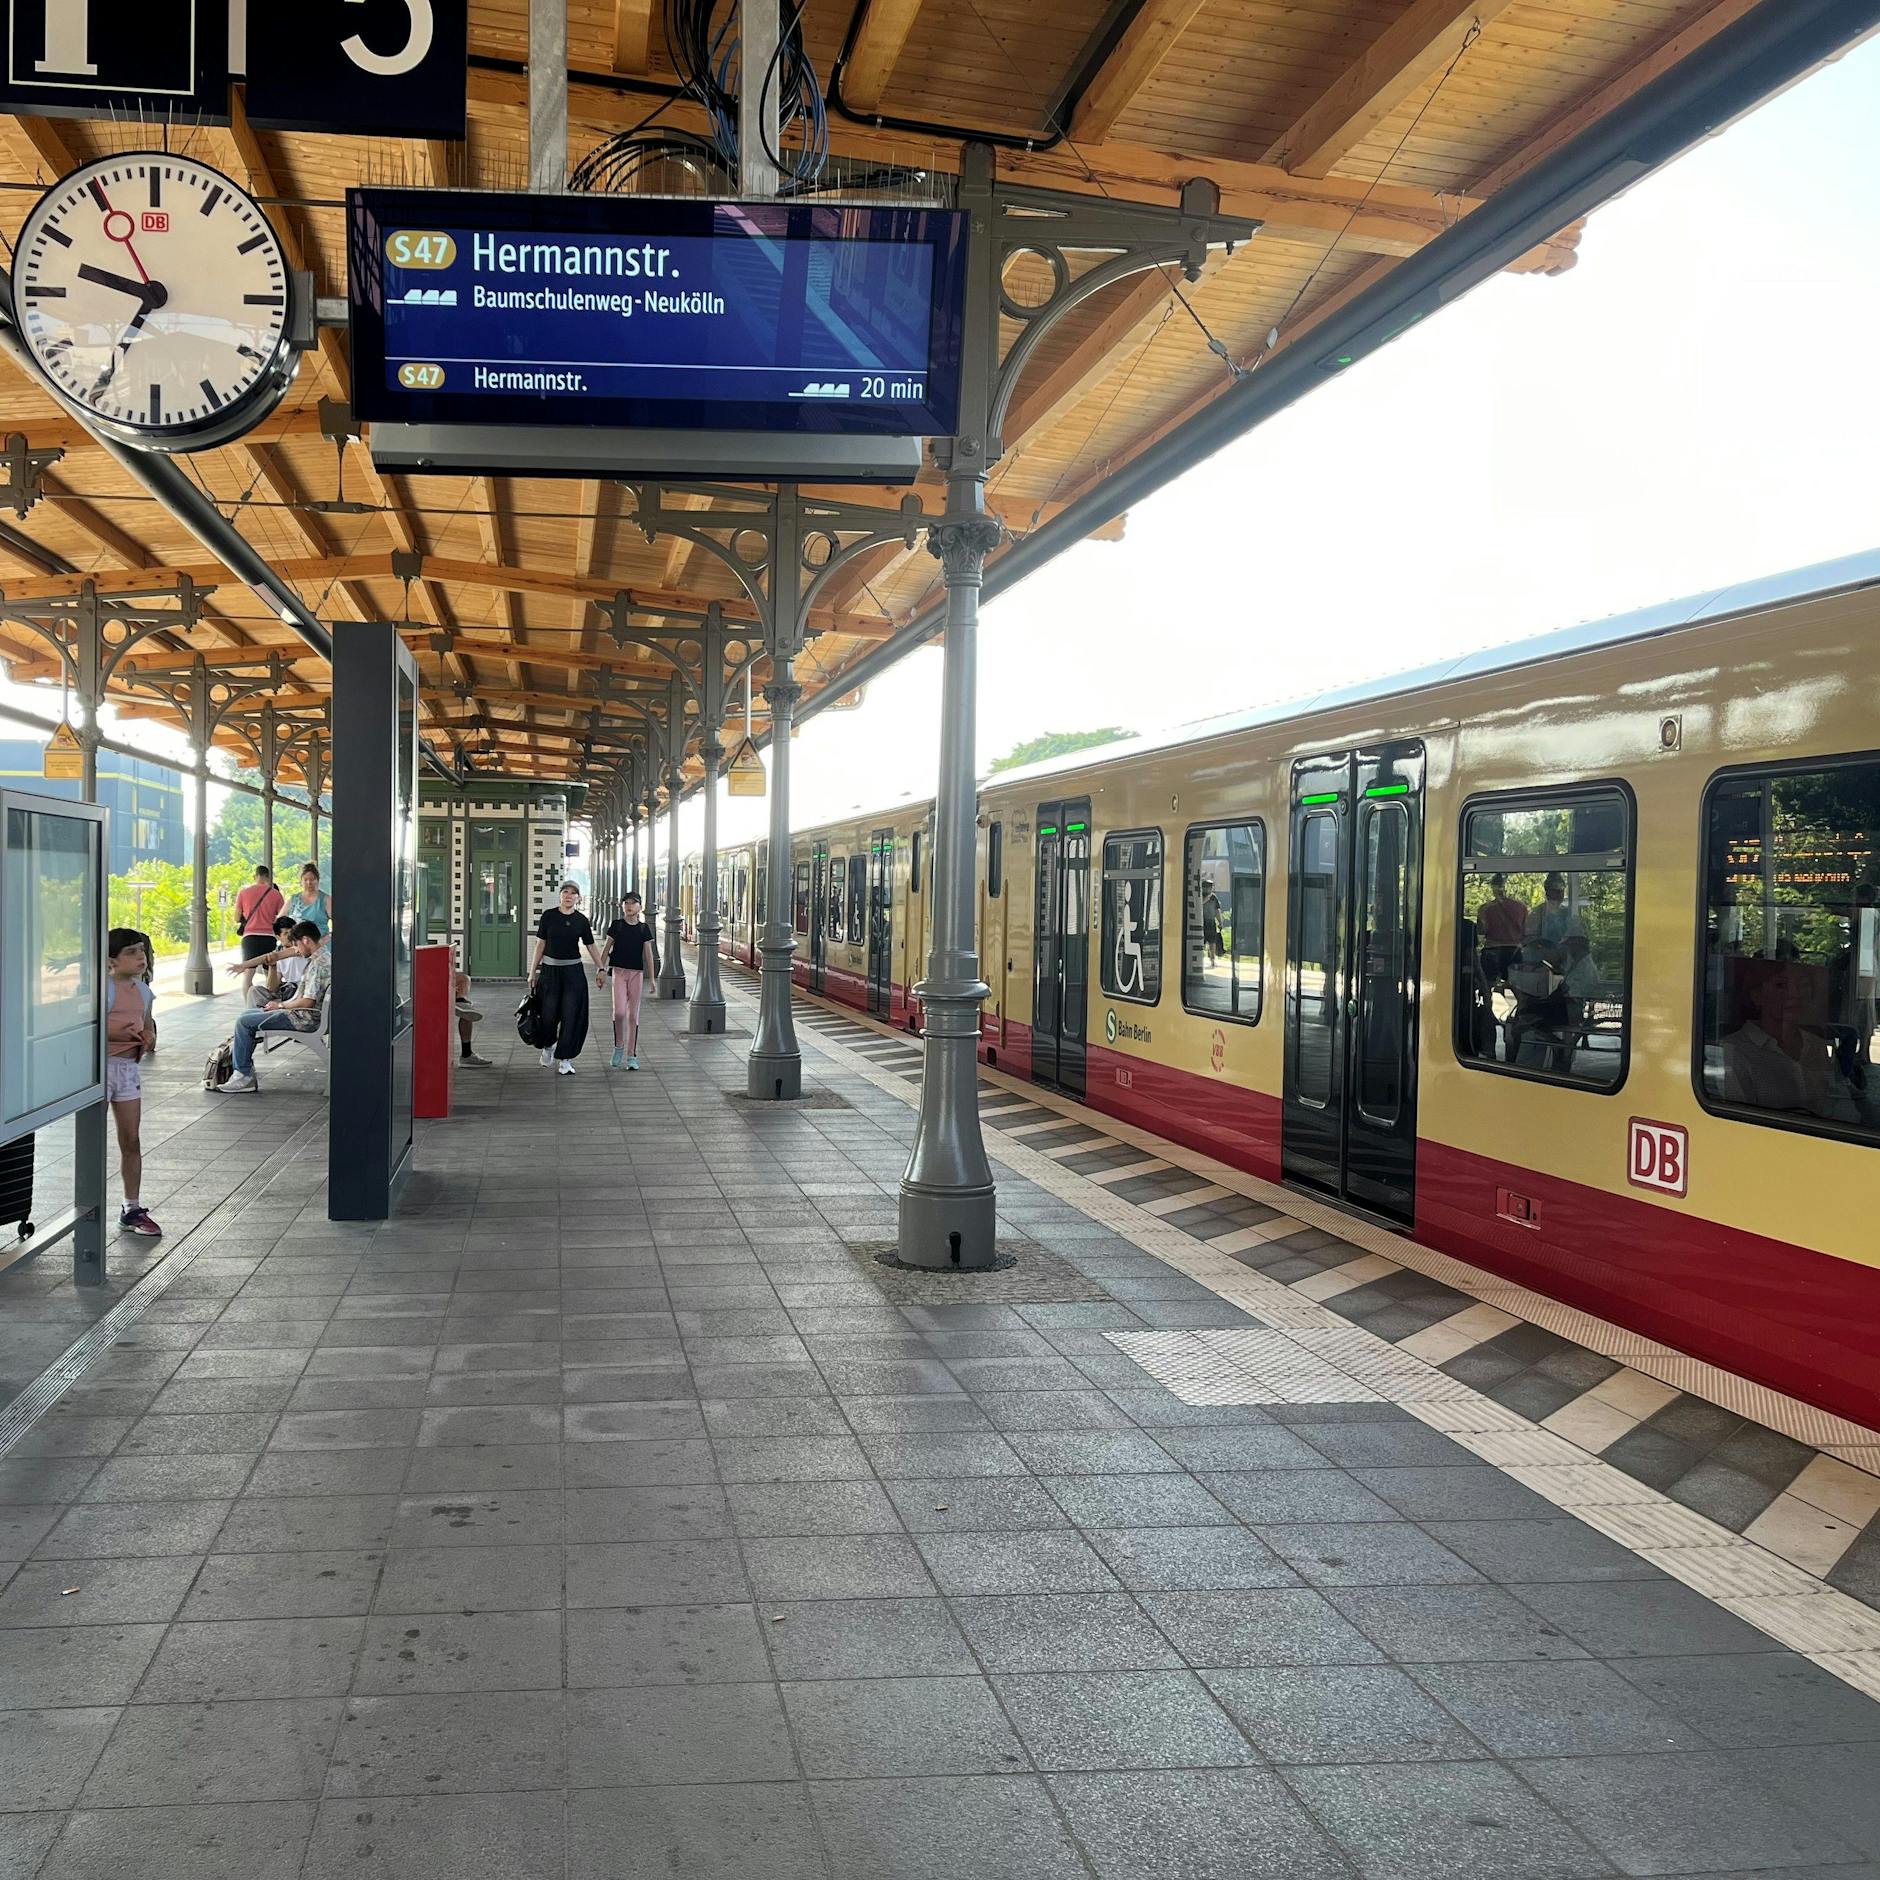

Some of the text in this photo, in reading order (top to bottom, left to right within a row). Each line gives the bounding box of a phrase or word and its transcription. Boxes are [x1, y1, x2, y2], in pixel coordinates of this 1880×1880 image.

[145, 215, 166, 229] DB
[394, 234, 448, 265] S47
[473, 232, 680, 278] Hermannstr.
[403, 366, 441, 386] S47
[474, 366, 588, 392] Hermannstr.
[860, 377, 923, 399] 20 min
[1118, 1020, 1132, 1039] Bahn
[1133, 1024, 1152, 1043] Berlin
[1634, 1128, 1681, 1185] DB
